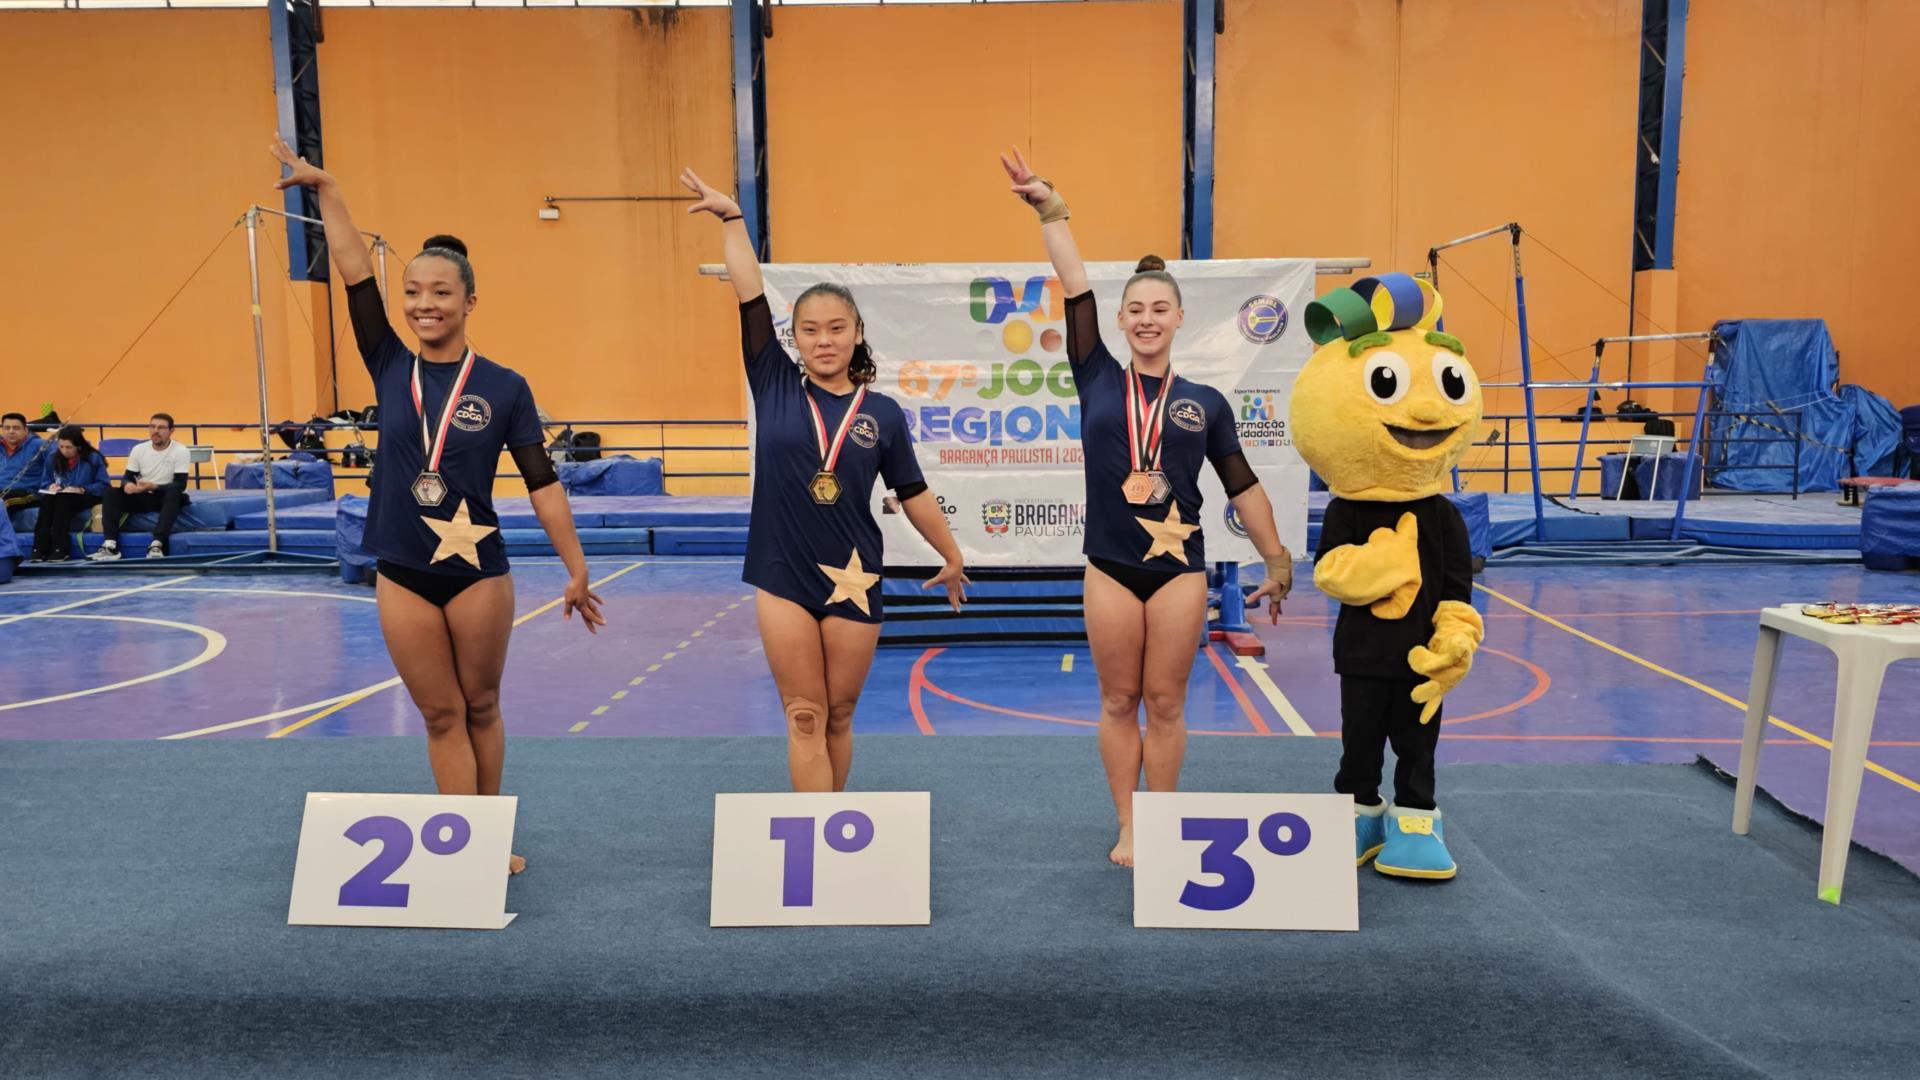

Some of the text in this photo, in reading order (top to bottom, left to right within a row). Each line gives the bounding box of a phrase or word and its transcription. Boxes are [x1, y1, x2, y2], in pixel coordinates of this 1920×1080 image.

[940, 450, 998, 468] BRAGANÇA
[1001, 448, 1052, 464] PAULISTA
[1015, 526, 1083, 537] PAULISTA
[338, 812, 471, 908] 2º
[770, 810, 875, 907] 1º
[1179, 812, 1311, 911] 3º
